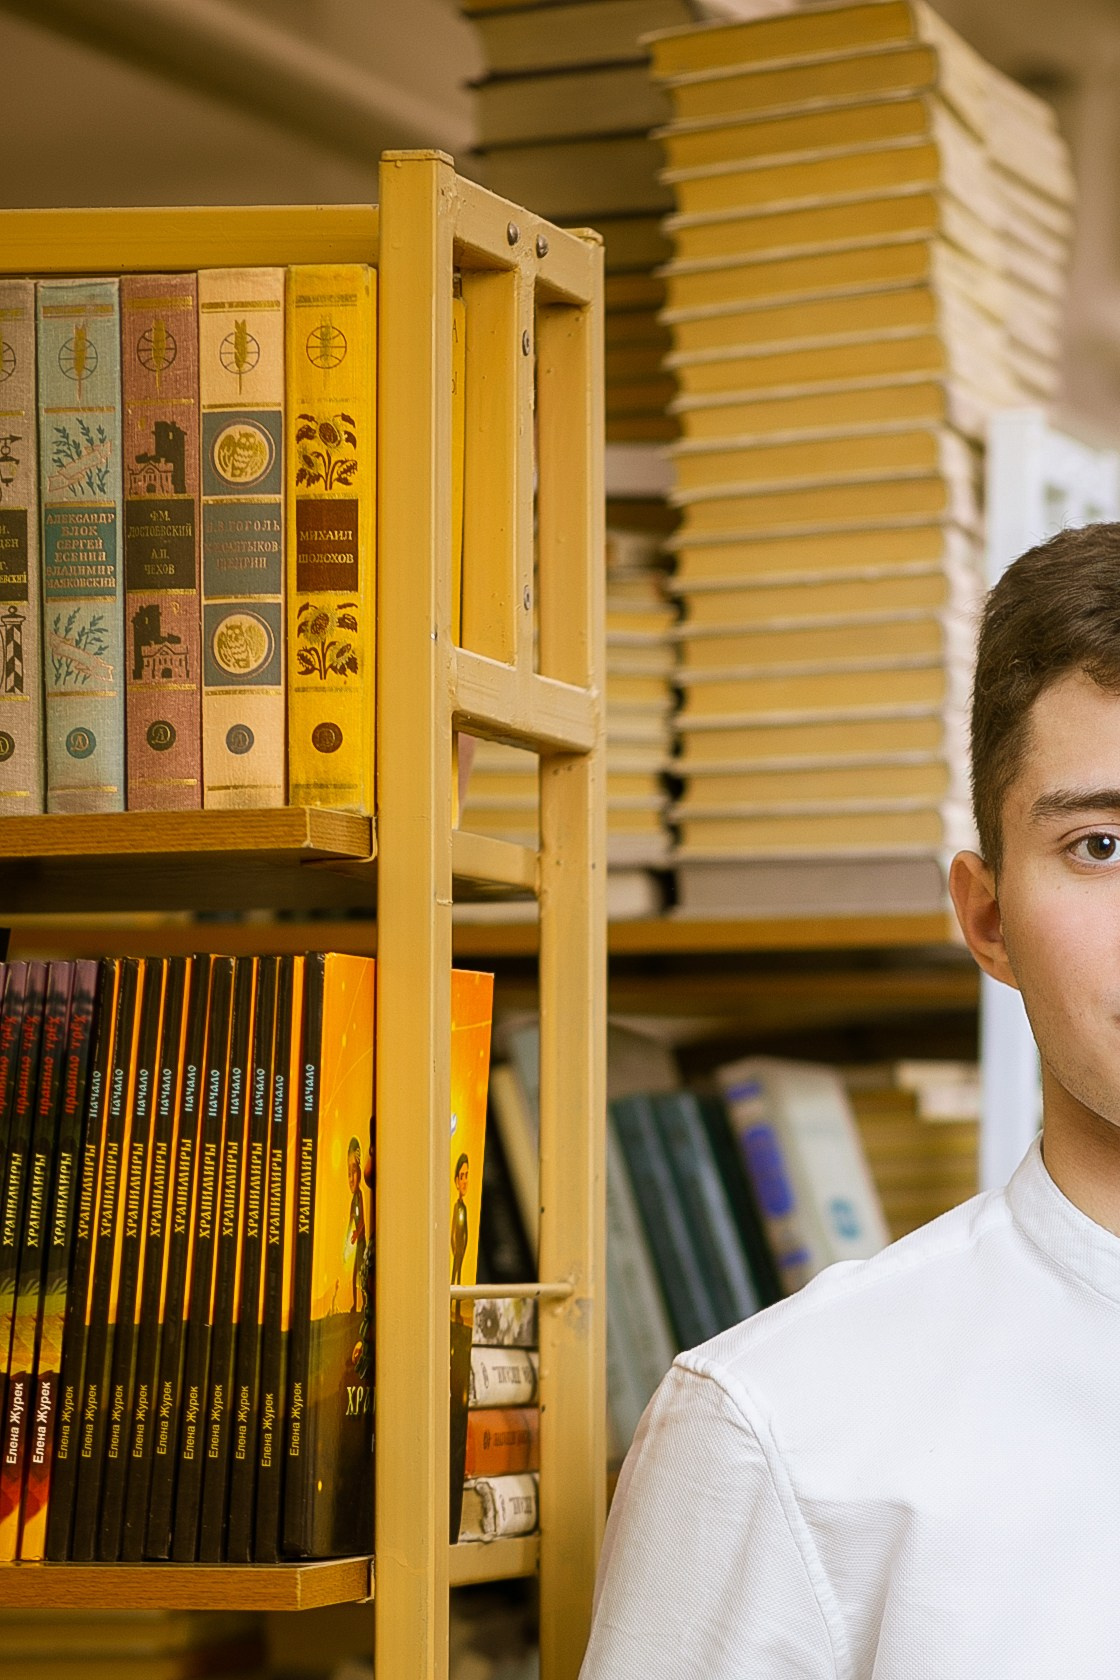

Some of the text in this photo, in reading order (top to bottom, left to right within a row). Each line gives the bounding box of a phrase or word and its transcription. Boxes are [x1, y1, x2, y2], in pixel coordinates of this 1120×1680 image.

[46, 513, 115, 525] АЛЕКСАНДР
[56, 537, 103, 550] СЕРГЕЙ
[61, 526, 98, 536] БЛОК
[128, 523, 192, 538] ДОСТОЕВСКИЙ
[299, 530, 353, 541] МИХАИЛ
[46, 566, 114, 577] ВЛАДИМИР
[46, 577, 116, 589] МАЯКОВСКИЙ
[54, 552, 106, 563] ЕСЕНИН
[144, 563, 175, 575] ЧЕХОВ
[298, 553, 354, 564] ШОЛОХОВ
[3, 1152, 22, 1247] ХРАНИМИРЫ
[27, 1153, 46, 1247] ХРАНИМИРЫ
[54, 1152, 72, 1247] ХРАНИМИРЫ
[78, 1144, 96, 1239] ХРАНИМИРЫ
[101, 1142, 118, 1237] ХРАНИМИРЫ
[126, 1143, 143, 1238] ХРАНИМИРЫ
[150, 1142, 167, 1237] ХРАНИМИРЫ
[175, 1139, 192, 1234] ХРАНИМИРЫ
[199, 1143, 216, 1238] ХРАНИМИРЫ
[223, 1141, 238, 1236] ХРАНИМИРЫ
[248, 1142, 262, 1238] ХРАНИМИРЫ
[269, 1149, 282, 1245] ХРАНИМИРЫ
[299, 1138, 312, 1234] ХРАНИМИРЫ
[6, 1383, 24, 1464] Елена Журек
[32, 1382, 51, 1463] Елена Журек
[58, 1386, 74, 1459] Елена Журек
[82, 1384, 98, 1458] Елена Журек
[109, 1385, 124, 1458] Елена Журек
[132, 1384, 148, 1458] Елена Журек
[157, 1381, 172, 1454] Елена Журек
[184, 1386, 199, 1460] Елена Журек
[209, 1384, 223, 1458] Елена Журек
[236, 1386, 250, 1459] Елена Журек
[262, 1393, 275, 1467] Елена Журек
[290, 1383, 303, 1456] Елена Журек
